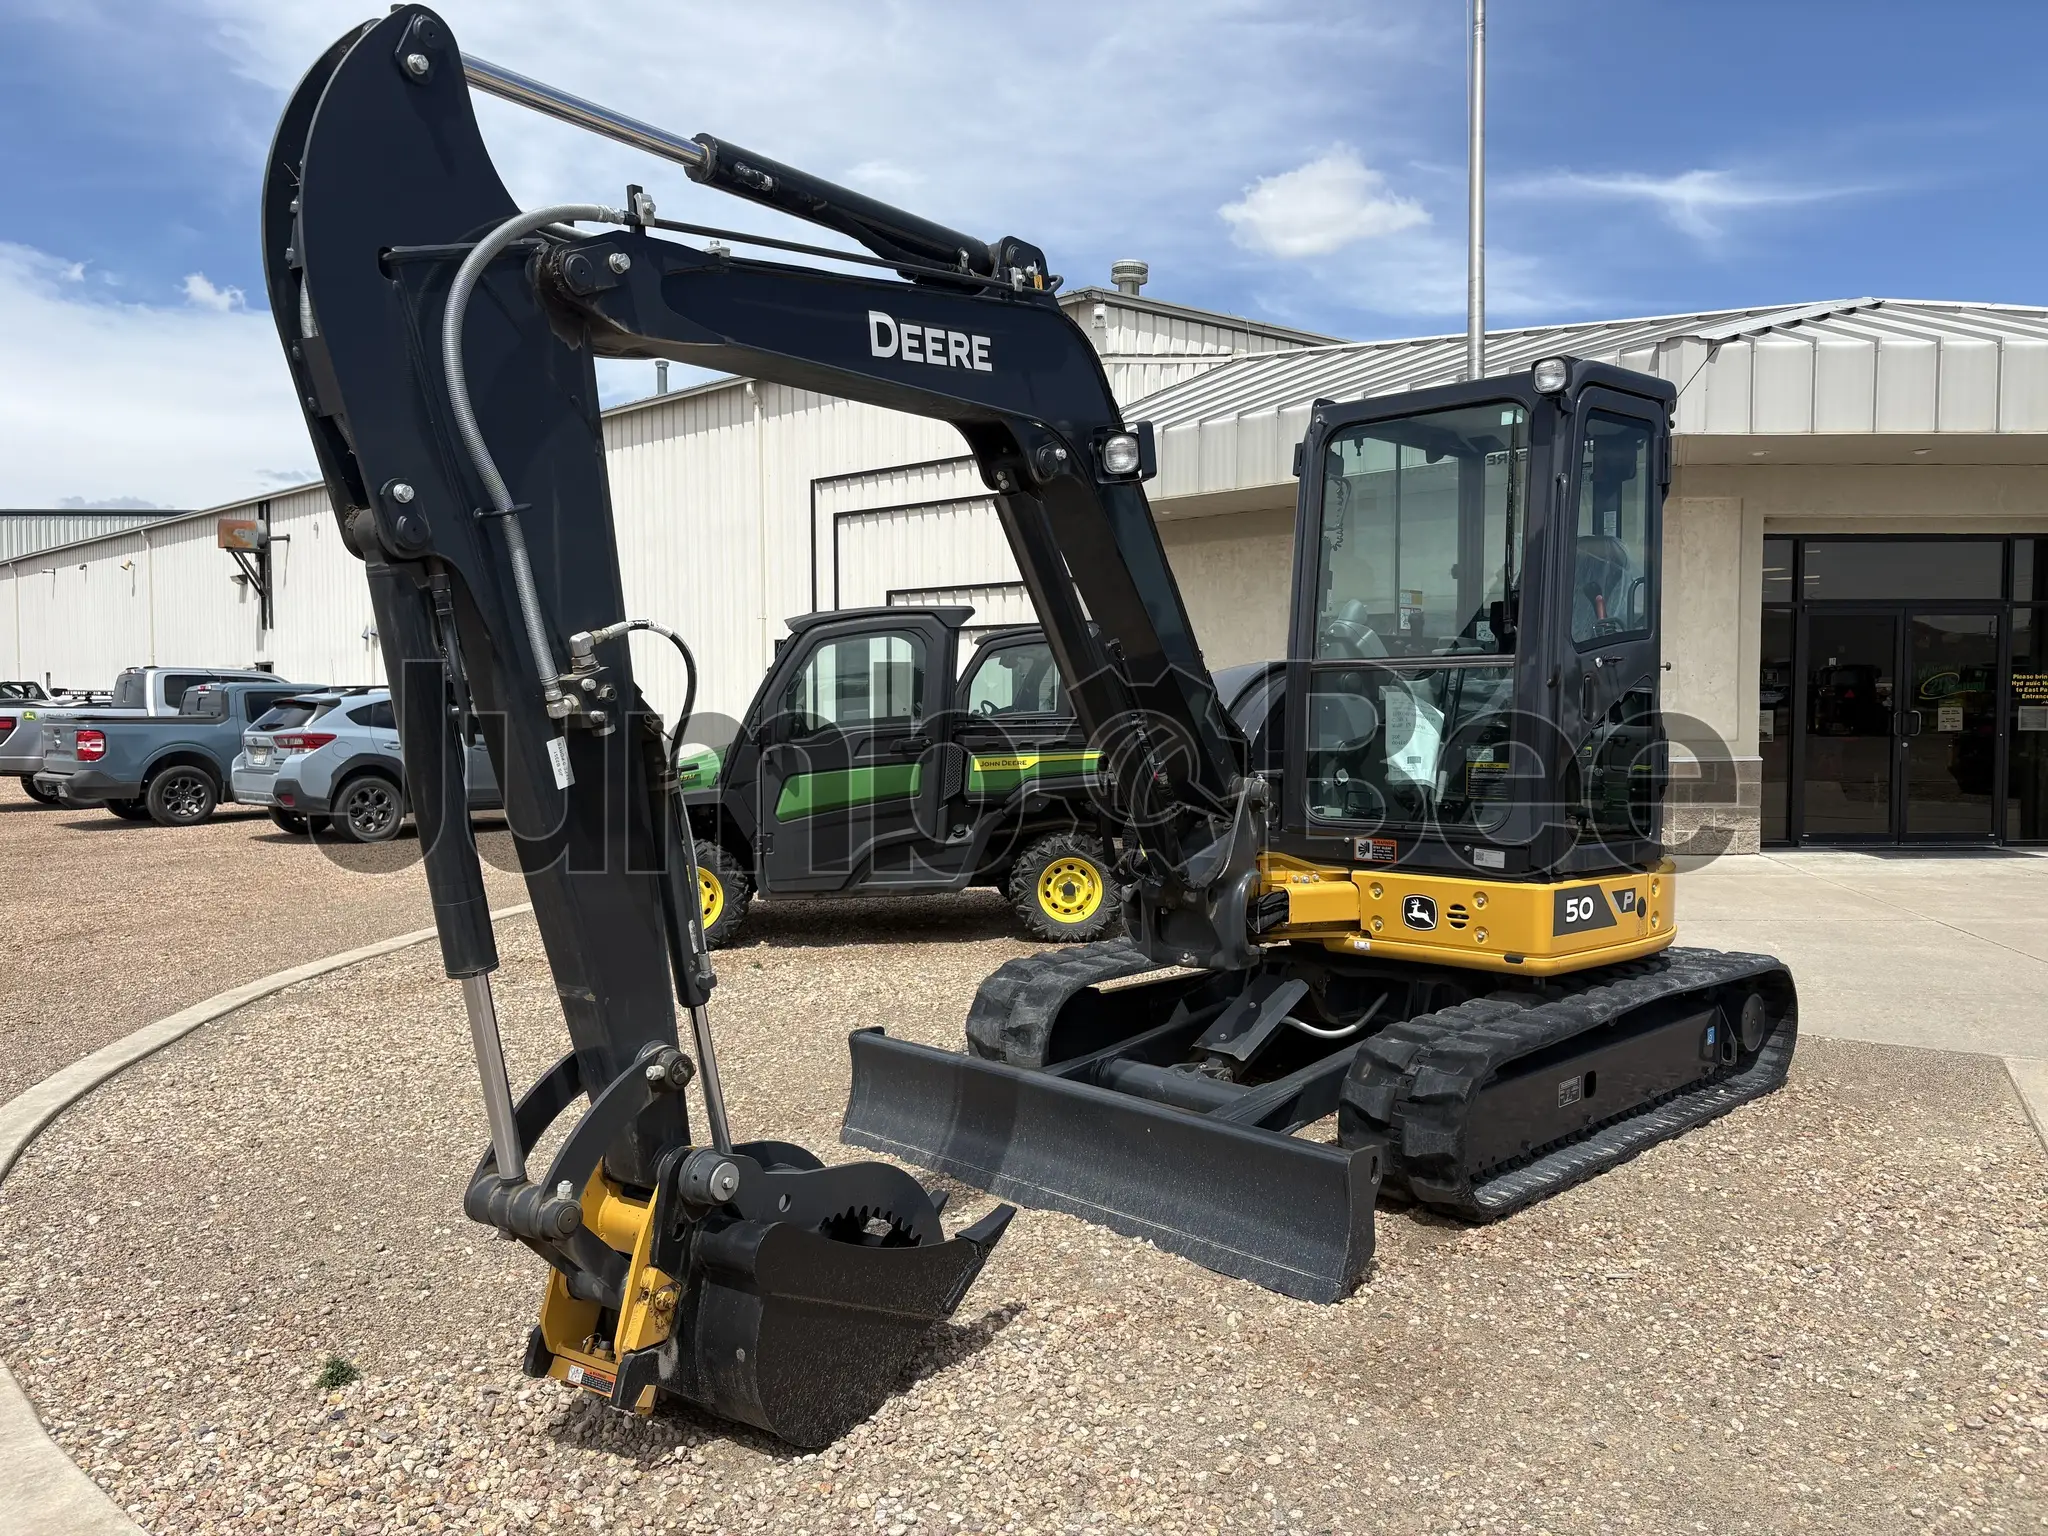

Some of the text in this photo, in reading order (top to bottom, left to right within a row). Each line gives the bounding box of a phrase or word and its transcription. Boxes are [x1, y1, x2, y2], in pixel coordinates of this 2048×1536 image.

[868, 310, 992, 371] DEERE
[1002, 759, 1027, 767] DEERE
[1566, 897, 1594, 922] 50
[1623, 892, 1633, 910] P
